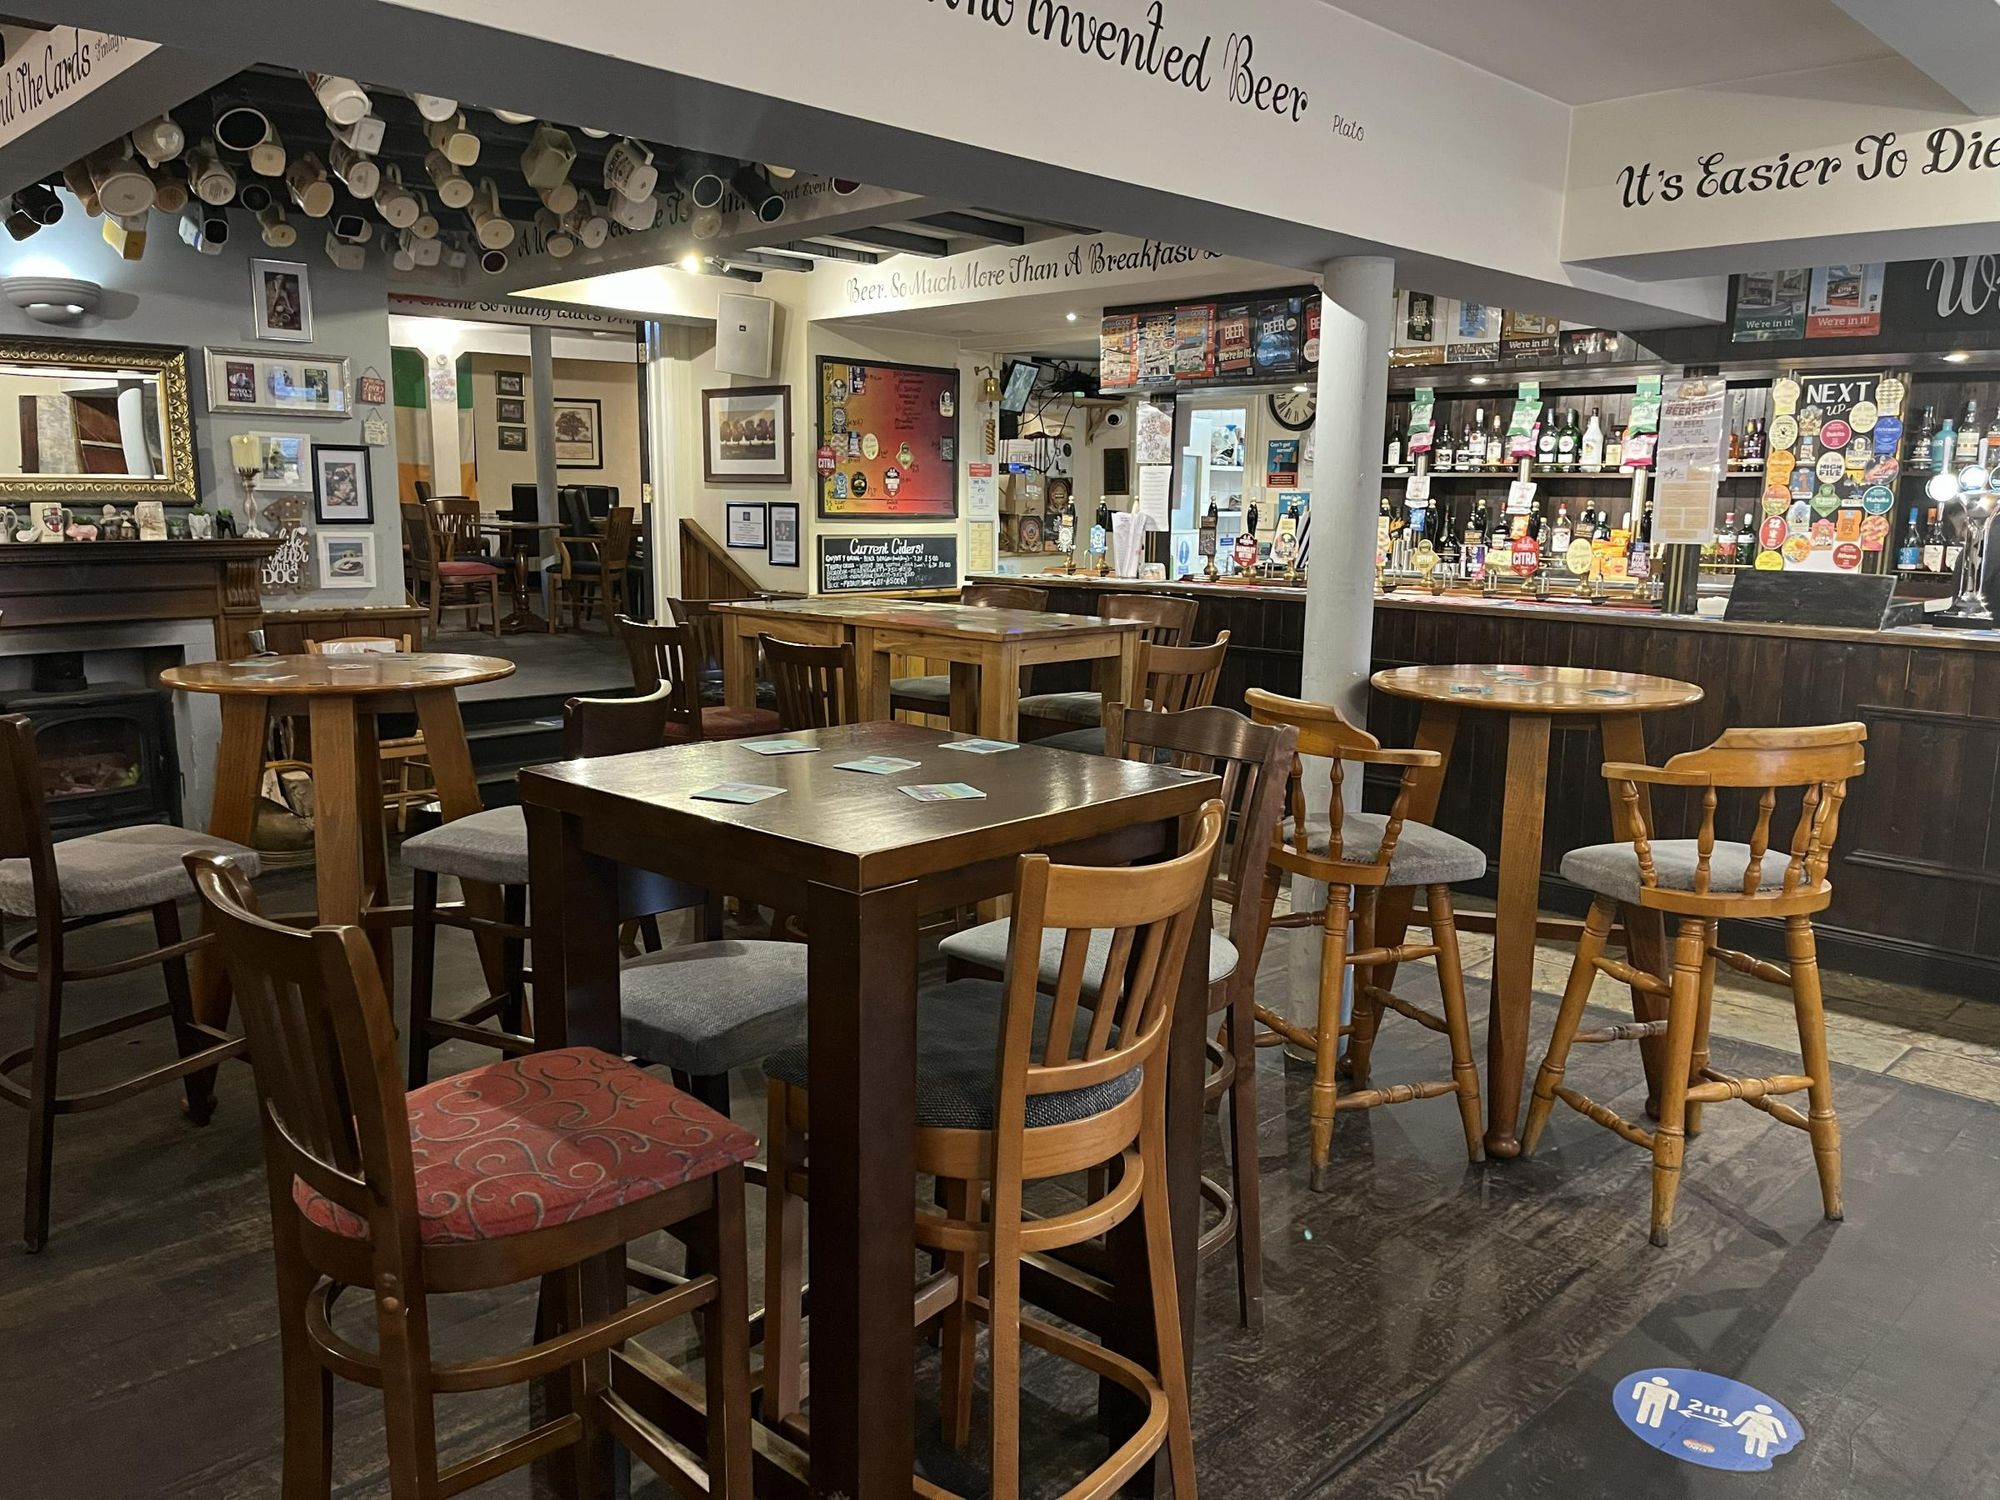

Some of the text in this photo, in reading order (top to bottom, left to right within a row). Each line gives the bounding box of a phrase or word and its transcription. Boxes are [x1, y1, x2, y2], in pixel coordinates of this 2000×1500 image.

[17, 61, 44, 114] The
[45, 28, 91, 99] Cards
[1224, 33, 1308, 122] Beer
[1332, 114, 1365, 142] Plato
[1616, 162, 1684, 208] It's
[1696, 152, 1842, 199] Easier
[1854, 131, 1908, 182] To
[847, 278, 887, 303] Beer.
[890, 273, 908, 299] So
[908, 269, 957, 297] Much
[959, 263, 1005, 289] More
[1009, 255, 1059, 284] Than
[1065, 246, 1083, 276] A
[1088, 238, 1199, 274] Breakfast
[1263, 318, 1285, 336] BEER
[1746, 318, 1794, 329] We're in it!
[1818, 315, 1870, 327] We're in it!
[1224, 323, 1245, 340] BEER
[1509, 338, 1550, 350] We're in it!
[1806, 381, 1872, 404] NEXT
[817, 458, 835, 469] CITRA
[850, 538, 924, 555] Current Ciders!
[1513, 552, 1537, 566] CITRA
[262, 569, 298, 584] DOG
[1687, 1398, 1728, 1419] 2m
